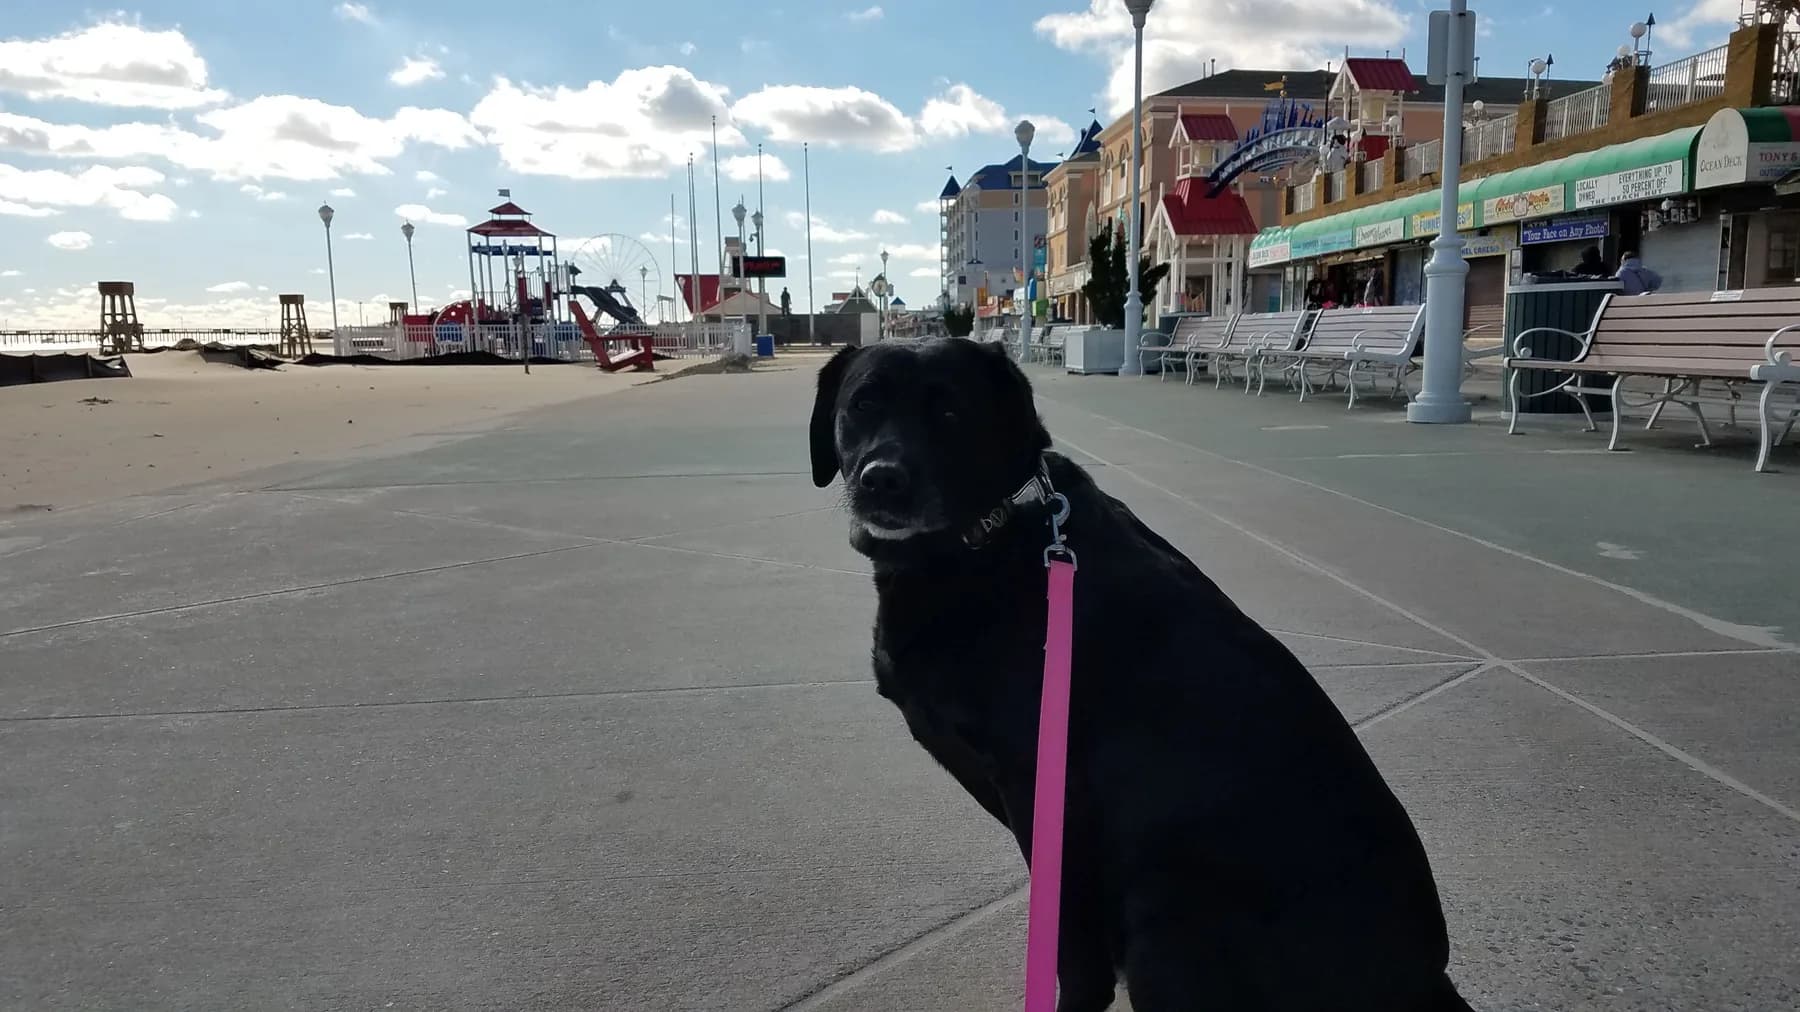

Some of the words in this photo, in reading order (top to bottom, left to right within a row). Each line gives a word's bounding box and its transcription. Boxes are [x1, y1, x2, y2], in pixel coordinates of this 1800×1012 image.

[1700, 159, 1722, 173] OCEAN
[1723, 154, 1742, 168] DECK
[1618, 167, 1653, 184] EVERYTHING
[1654, 166, 1662, 177] UP
[1664, 164, 1672, 176] TO
[1577, 179, 1598, 192] LOCALLY
[1622, 184, 1630, 194] 50
[1631, 179, 1655, 193] PERCENT
[1656, 177, 1667, 188] OFF
[1579, 190, 1596, 202] OWNED
[1419, 216, 1442, 232] FUNNE
[1543, 228, 1557, 239] Face
[1558, 229, 1568, 237] on
[1569, 225, 1584, 238] Any
